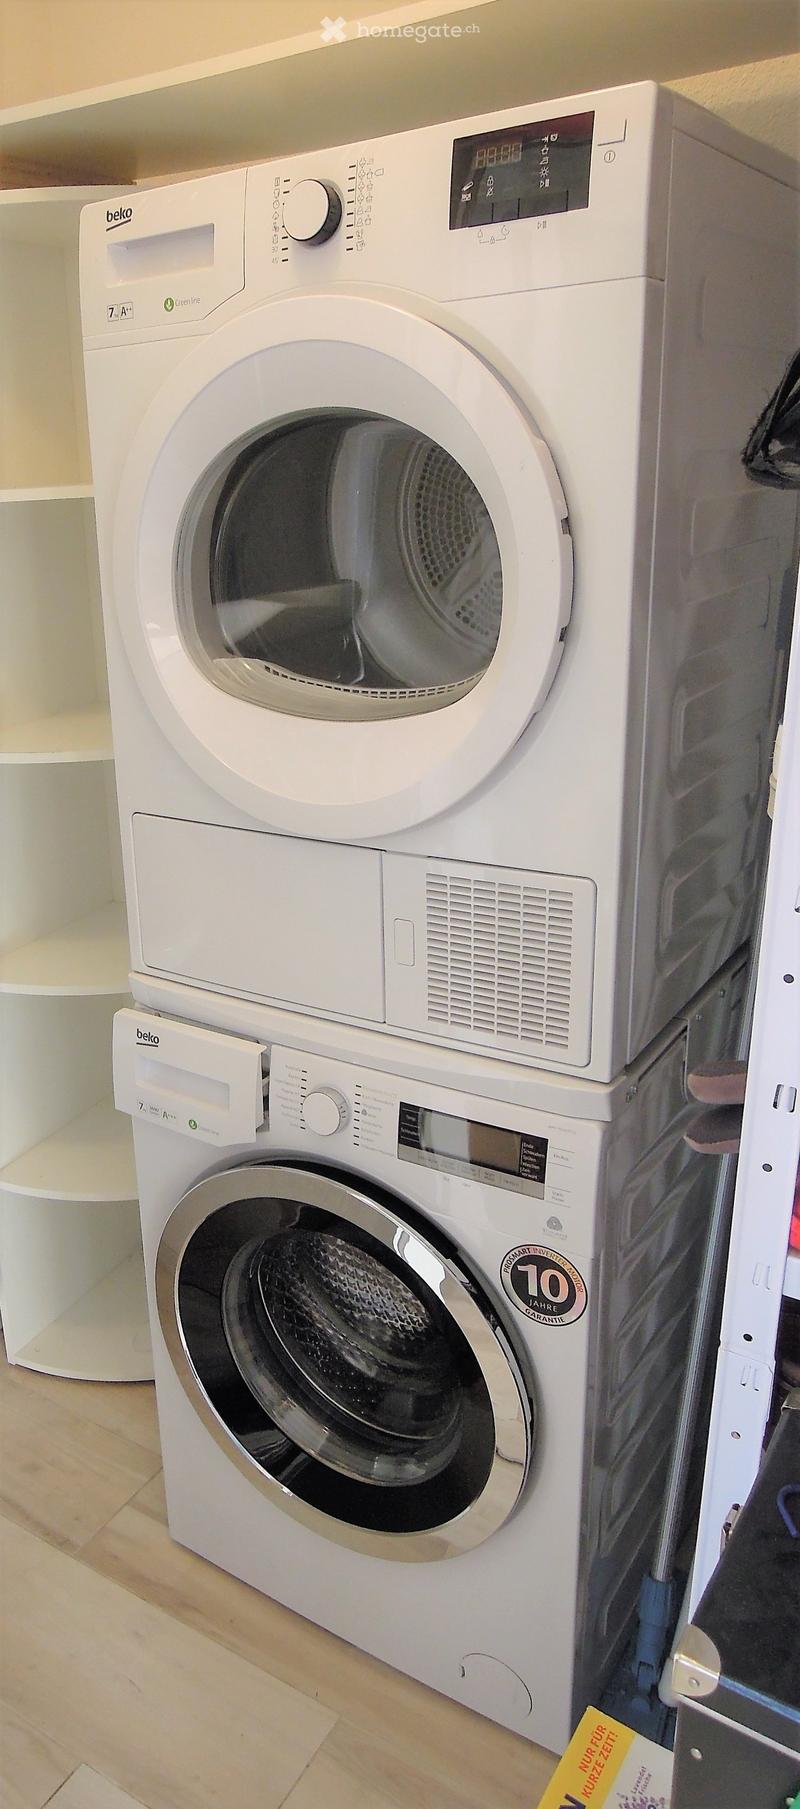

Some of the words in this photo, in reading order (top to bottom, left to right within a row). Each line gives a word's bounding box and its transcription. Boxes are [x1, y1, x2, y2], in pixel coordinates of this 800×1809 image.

[106, 207, 133, 223] beko
[136, 1028, 160, 1044] beko
[503, 1247, 532, 1274] PROSMART
[532, 1248, 568, 1268] INVERTER
[567, 1265, 584, 1293] MOTOR
[516, 1264, 569, 1304] 10
[525, 1309, 565, 1323] GARANTIE
[529, 1299, 558, 1312] JAHRE
[578, 1747, 596, 1774] NUR
[581, 1759, 605, 1800] KURZE
[599, 1731, 619, 1760] ZEIT!
